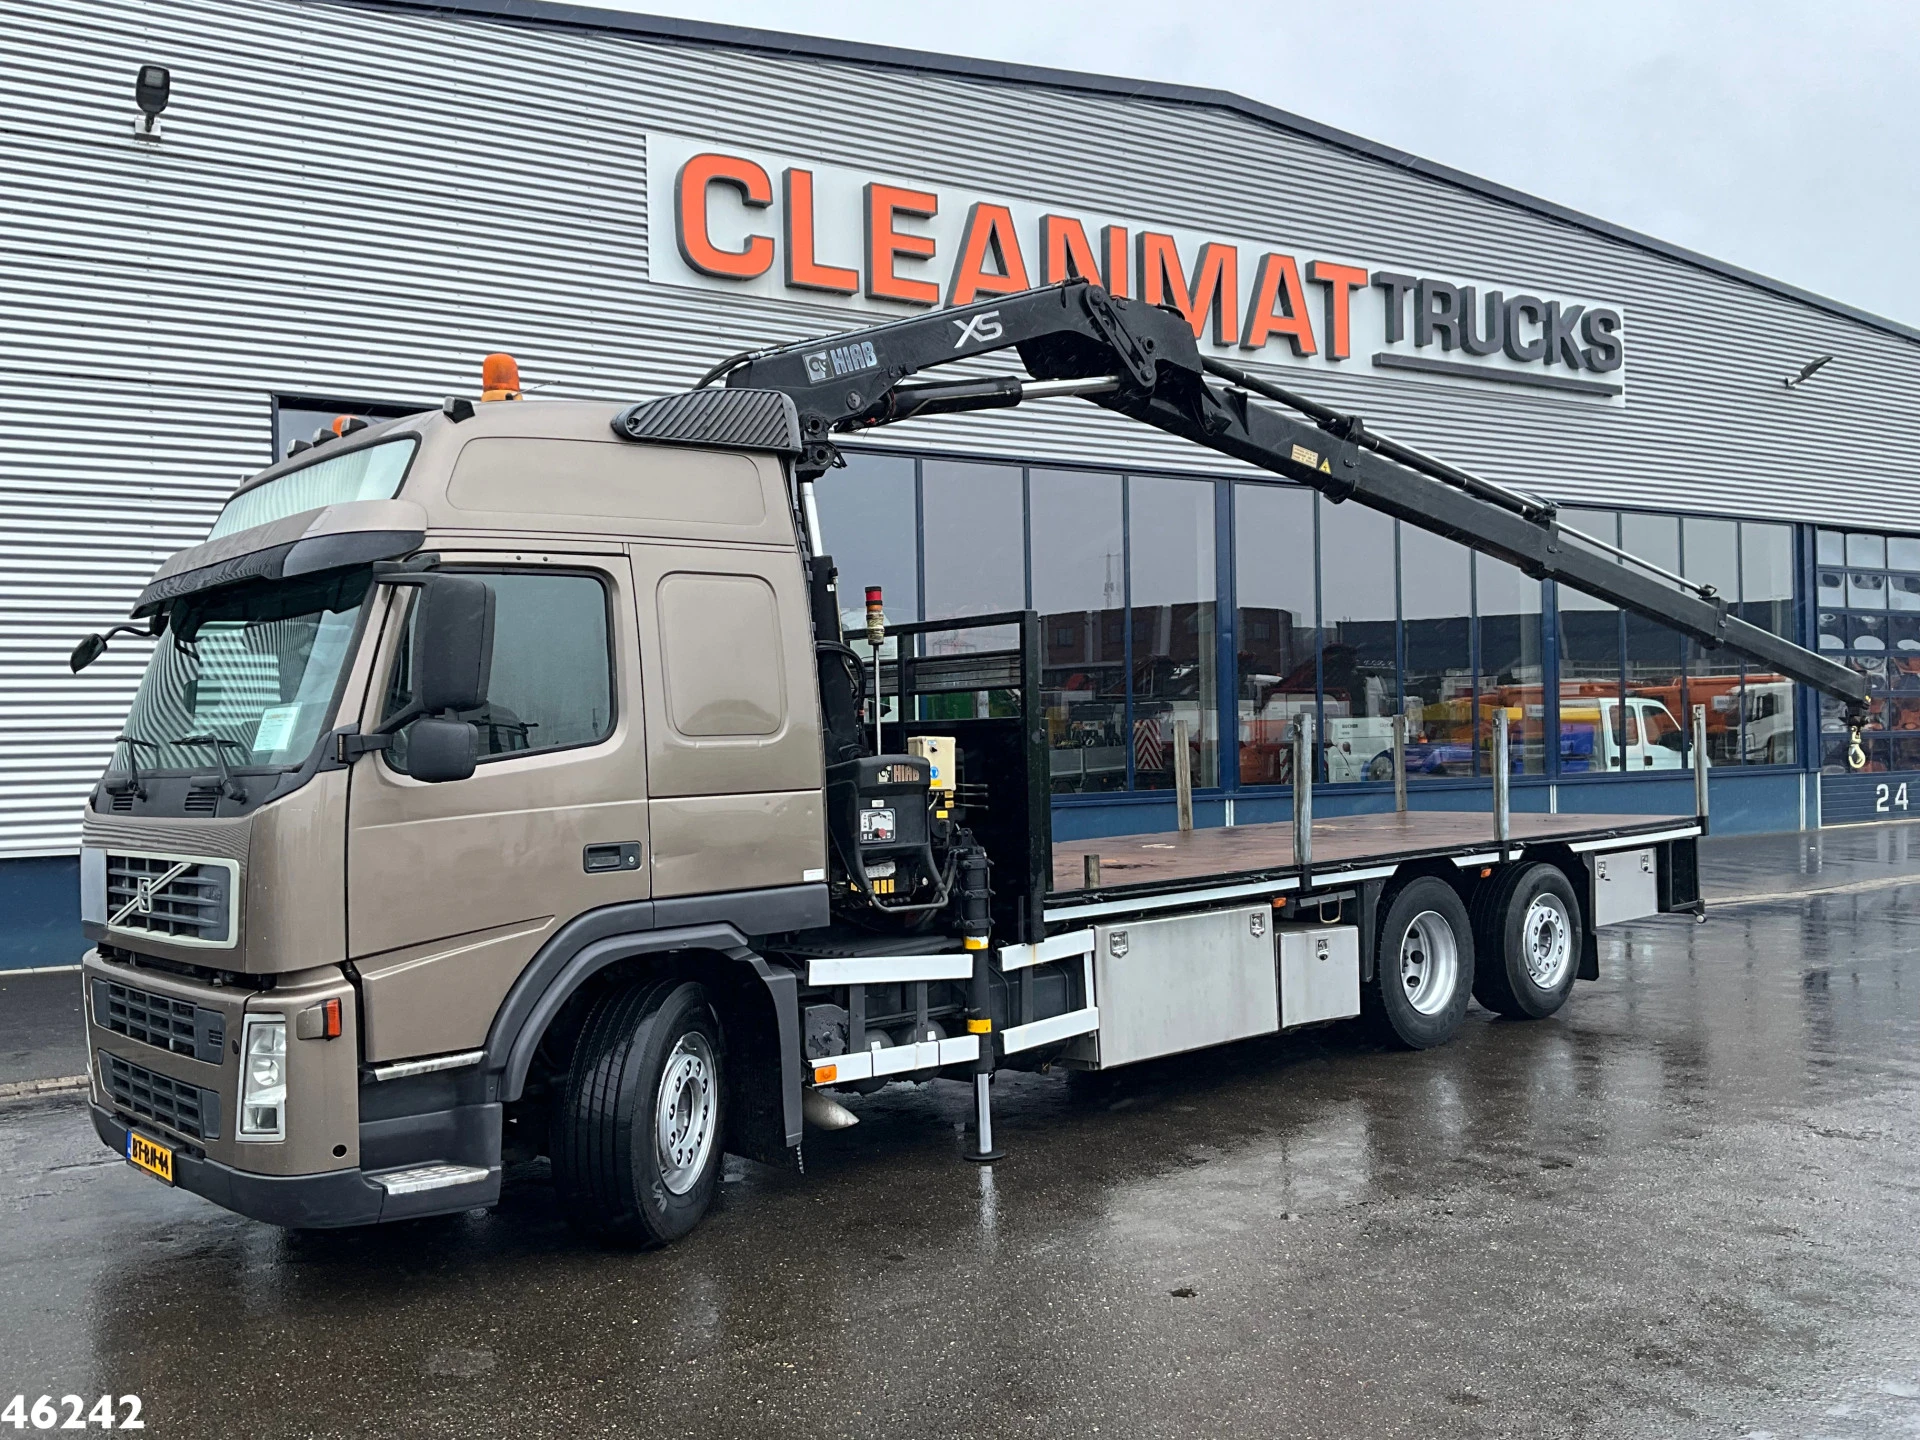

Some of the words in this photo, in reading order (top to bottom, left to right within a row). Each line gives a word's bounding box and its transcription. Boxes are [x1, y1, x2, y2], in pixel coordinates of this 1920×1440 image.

[675, 152, 1368, 360] CLEANMAT
[1371, 270, 1623, 372] TRUCKS
[953, 310, 1004, 349] XS
[830, 341, 877, 375] HIAB
[1876, 782, 1909, 812] 24
